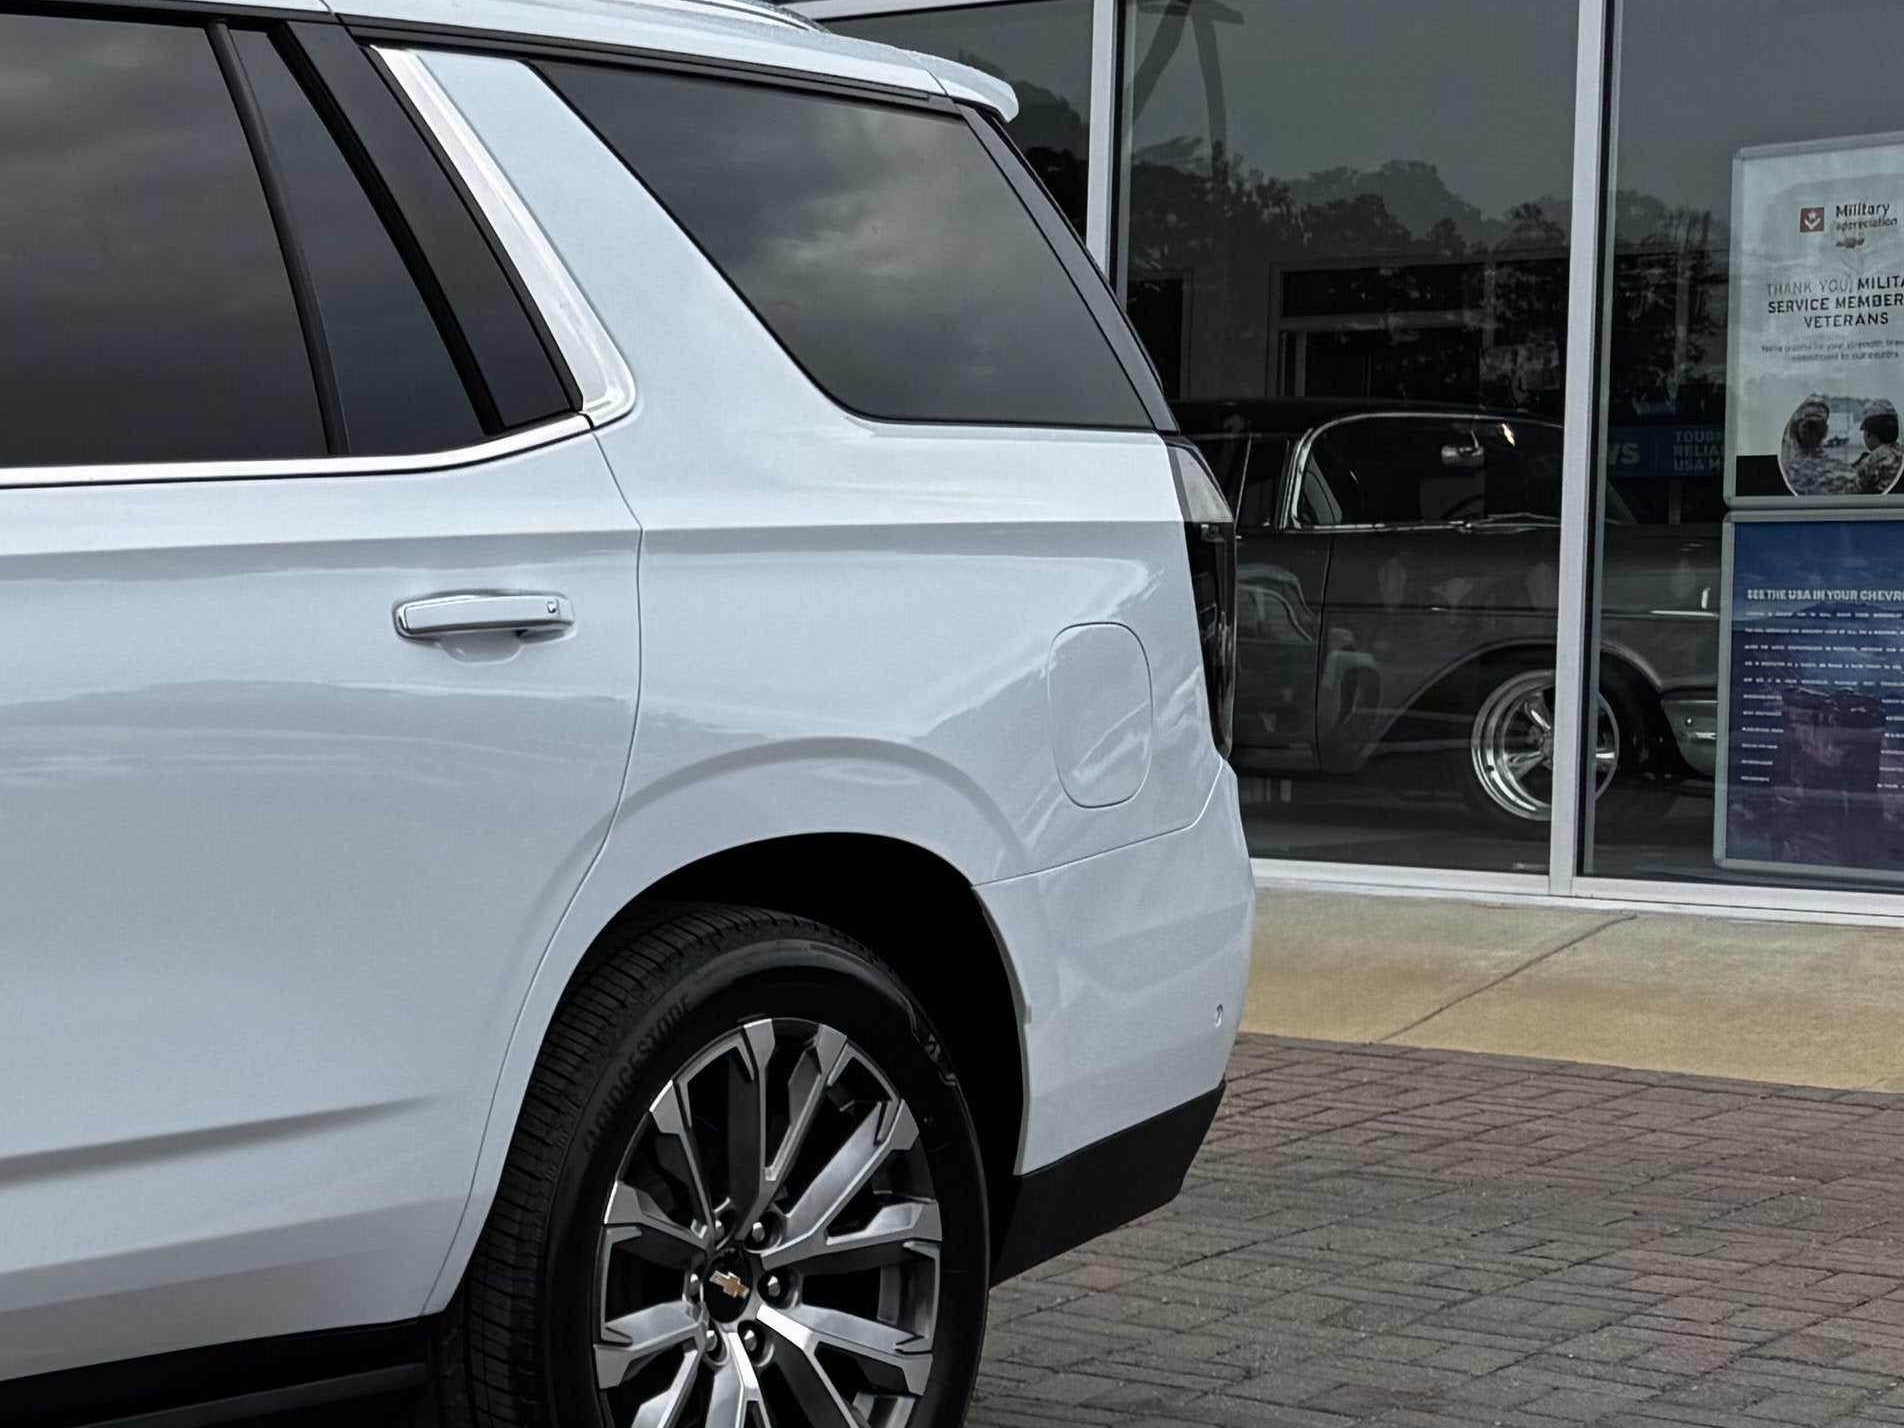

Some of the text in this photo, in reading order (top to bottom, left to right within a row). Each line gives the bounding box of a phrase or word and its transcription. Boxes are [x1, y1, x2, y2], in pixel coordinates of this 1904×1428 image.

[1835, 202, 1890, 220] Military
[1766, 281, 1812, 296] THANK
[1767, 297, 1830, 314] SERVICE
[1804, 312, 1889, 329] VETERANS
[1766, 588, 1786, 601] THE
[1788, 588, 1811, 601] USA
[1812, 588, 1826, 601] IN
[1827, 589, 1858, 601] YOUR
